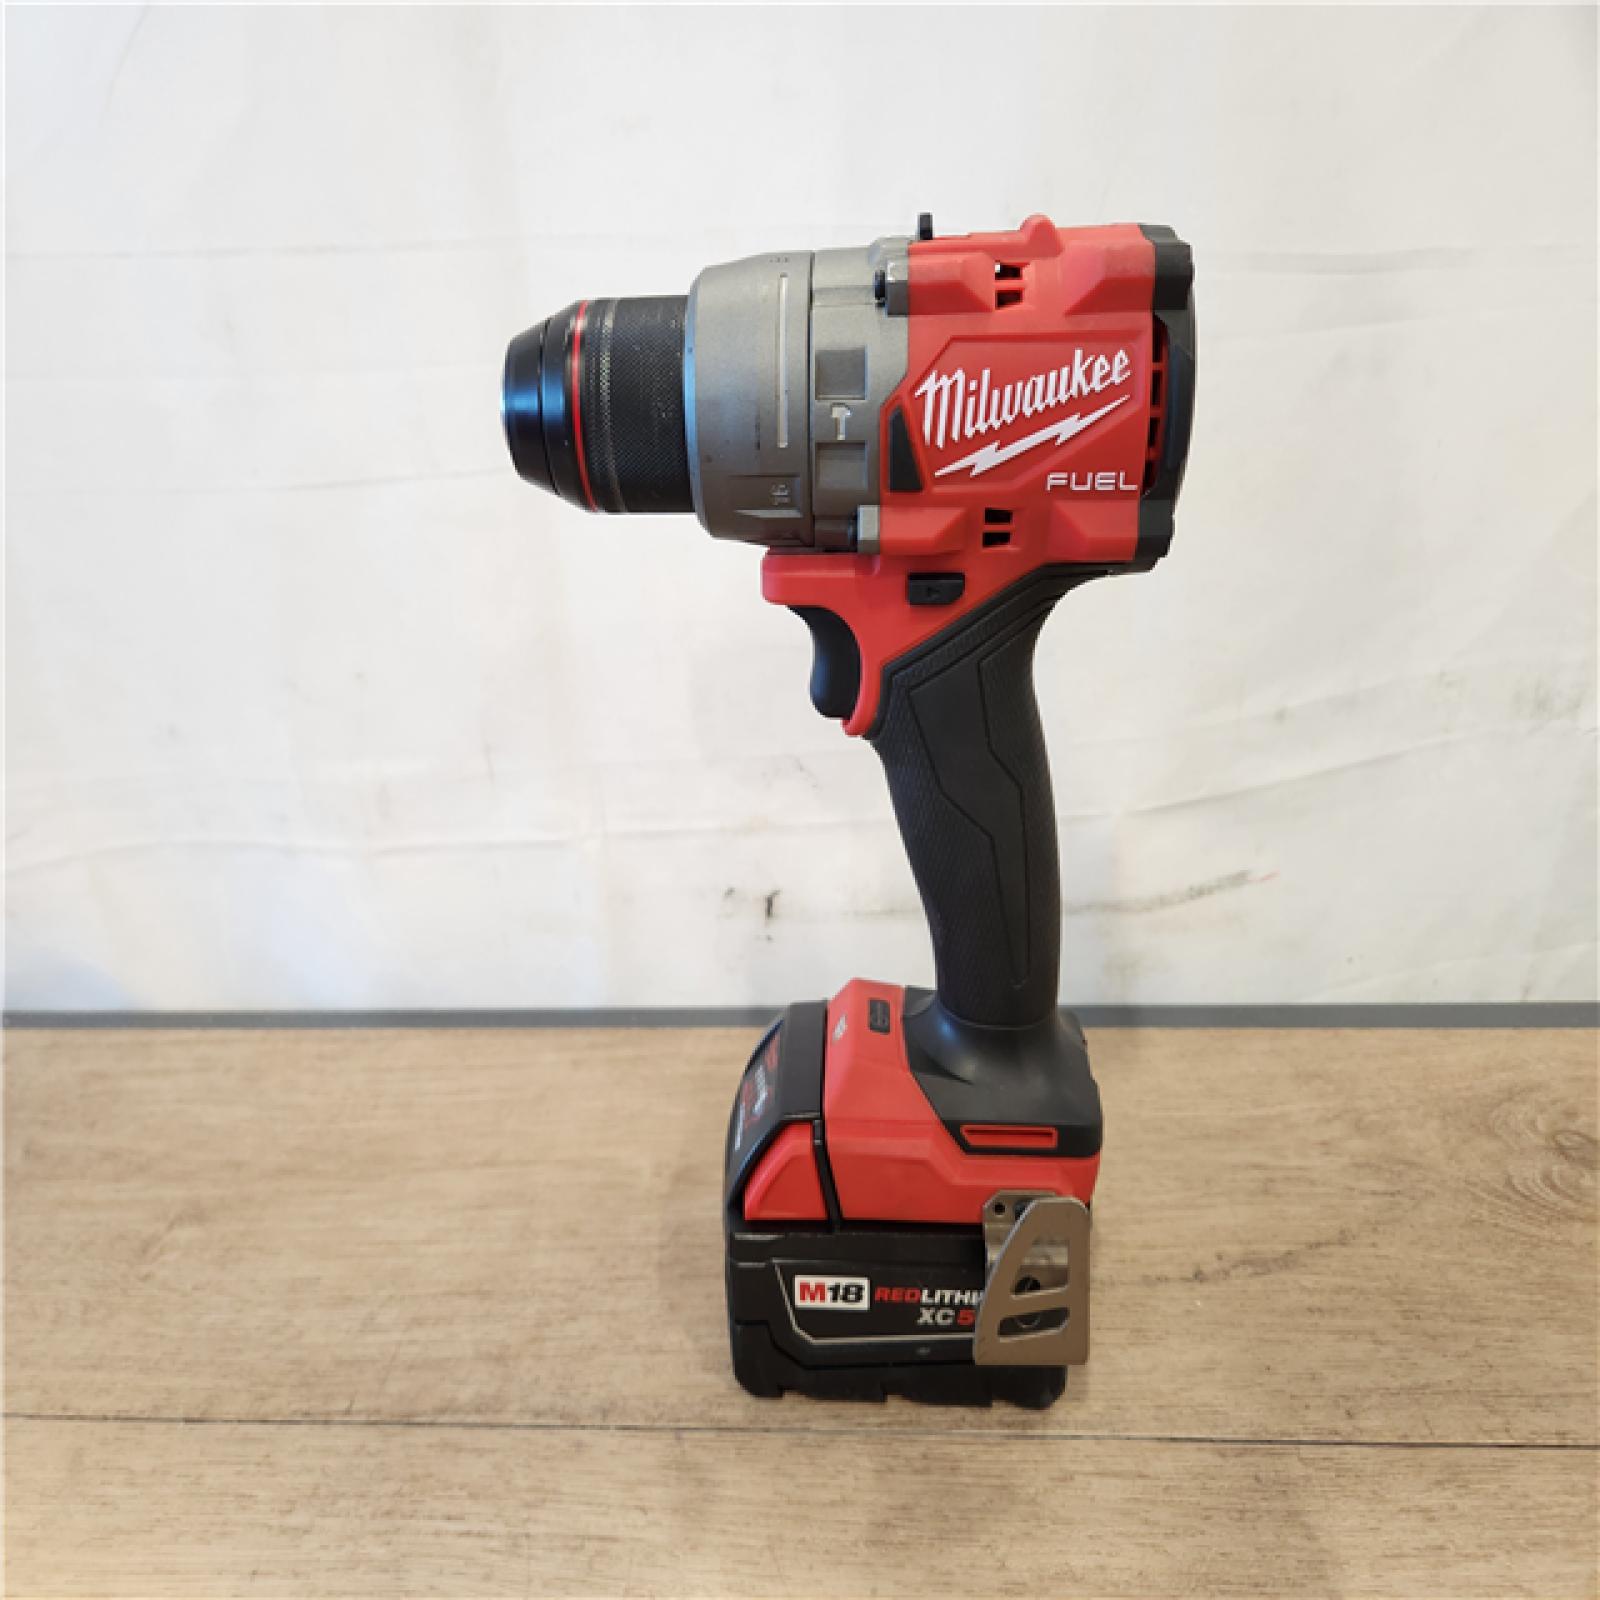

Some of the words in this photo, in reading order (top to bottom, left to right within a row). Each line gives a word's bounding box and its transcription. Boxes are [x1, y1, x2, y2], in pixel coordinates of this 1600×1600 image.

[915, 348, 1131, 449] Milwaukee
[1046, 472, 1138, 491] FUEL
[799, 1281, 866, 1304] M18
